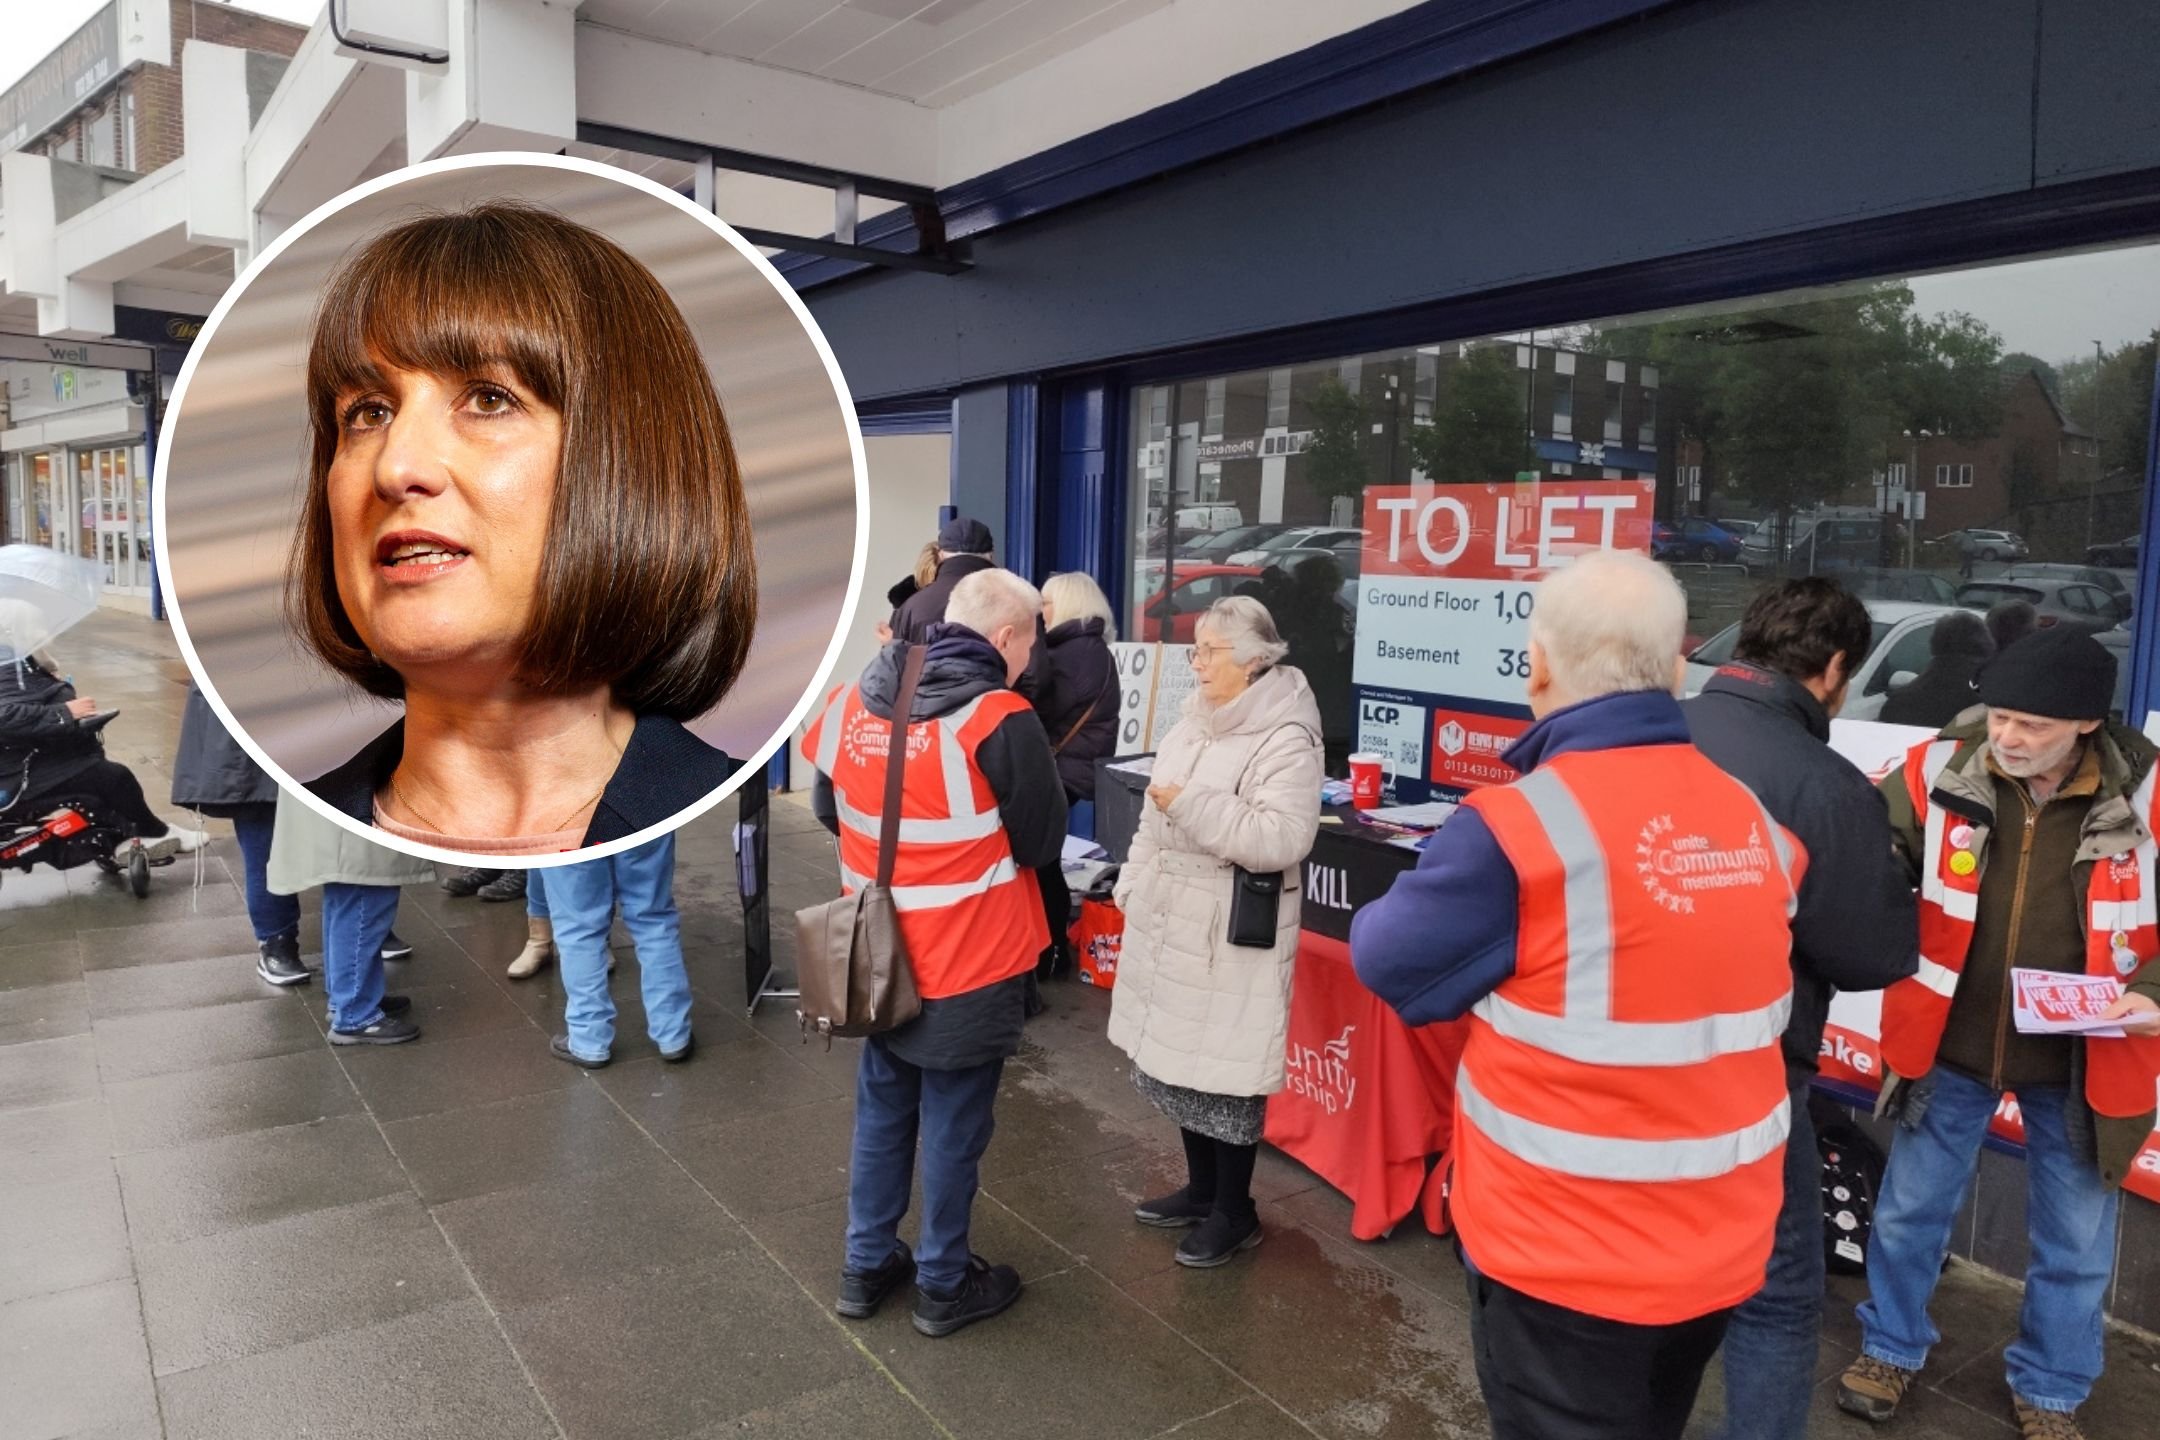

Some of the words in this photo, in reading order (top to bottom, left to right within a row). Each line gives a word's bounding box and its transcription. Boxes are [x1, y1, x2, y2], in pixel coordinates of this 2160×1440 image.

[51, 346, 88, 362] well
[1376, 497, 1470, 566] TO
[1494, 495, 1637, 568] LET
[1368, 588, 1429, 610] Ground
[1433, 591, 1480, 612] Floor
[1377, 640, 1460, 665] Basement
[1496, 649, 1532, 677] 38
[853, 729, 932, 752] Commnity
[1444, 759, 1468, 773] 0113
[1469, 764, 1488, 777] 433
[1489, 768, 1516, 781] 0117
[1672, 834, 1709, 851] unite
[1654, 847, 1770, 876] Community
[1307, 861, 1352, 910] KILL
[1679, 869, 1764, 891] membership
[2029, 986, 2054, 1001] WE
[2057, 985, 2082, 1001] DID
[2083, 983, 2115, 1001] NOT
[2043, 1000, 2082, 1015] VOTE
